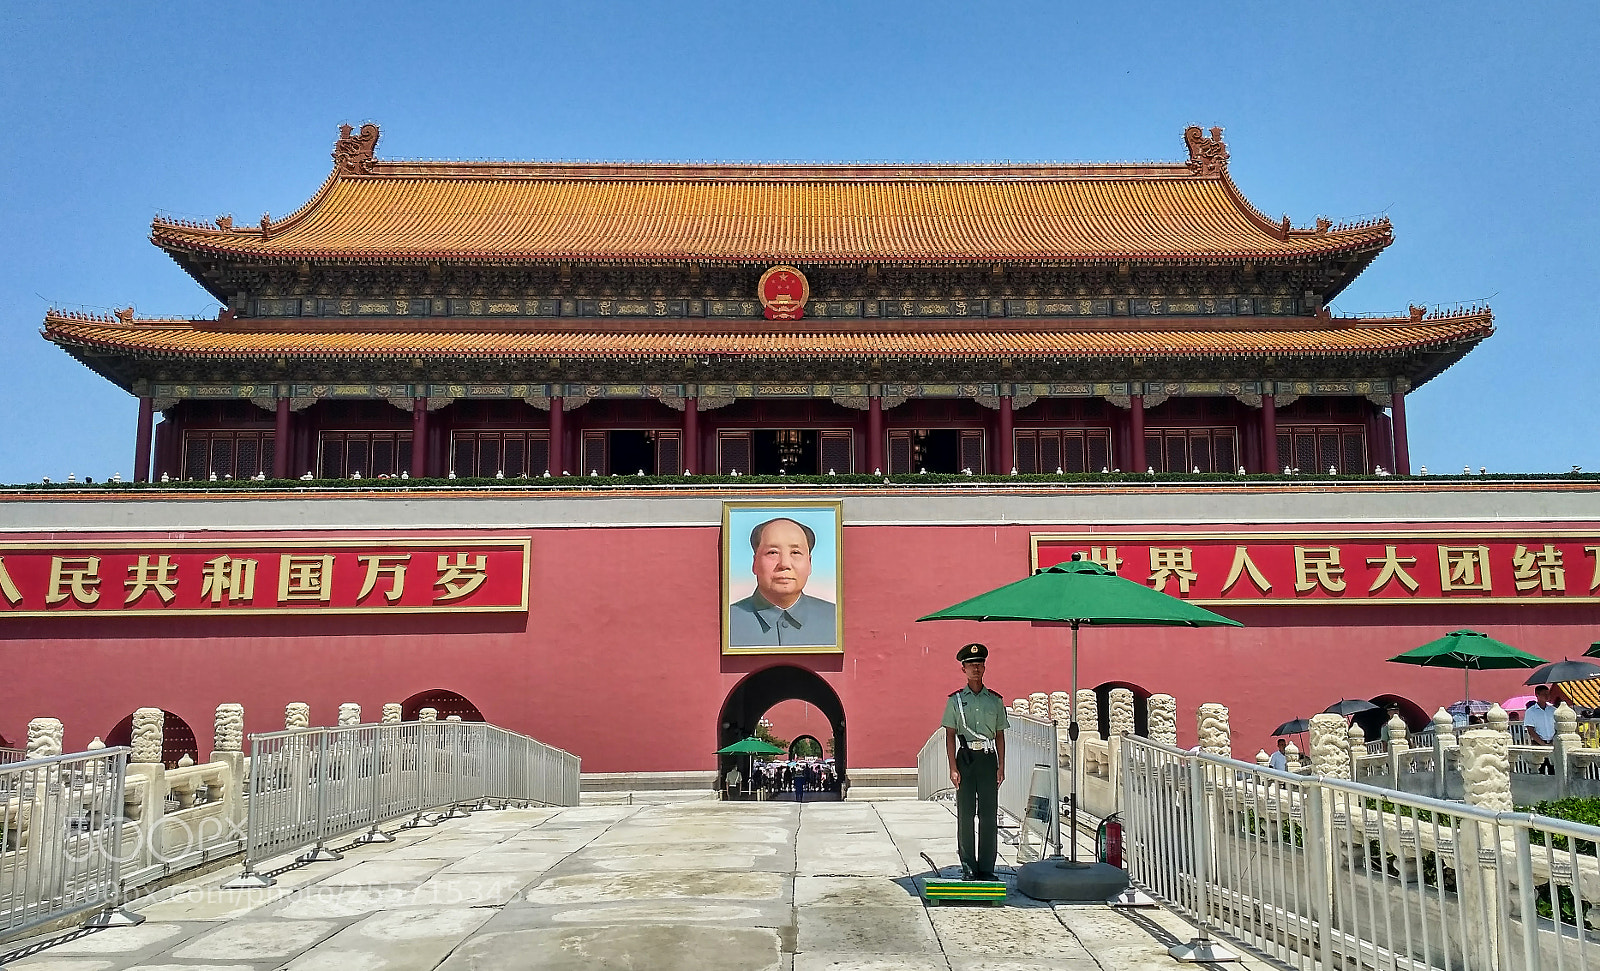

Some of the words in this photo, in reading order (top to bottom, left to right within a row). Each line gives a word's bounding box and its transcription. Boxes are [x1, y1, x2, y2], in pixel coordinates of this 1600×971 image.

[1078, 544, 1600, 593] 界人民大团结
